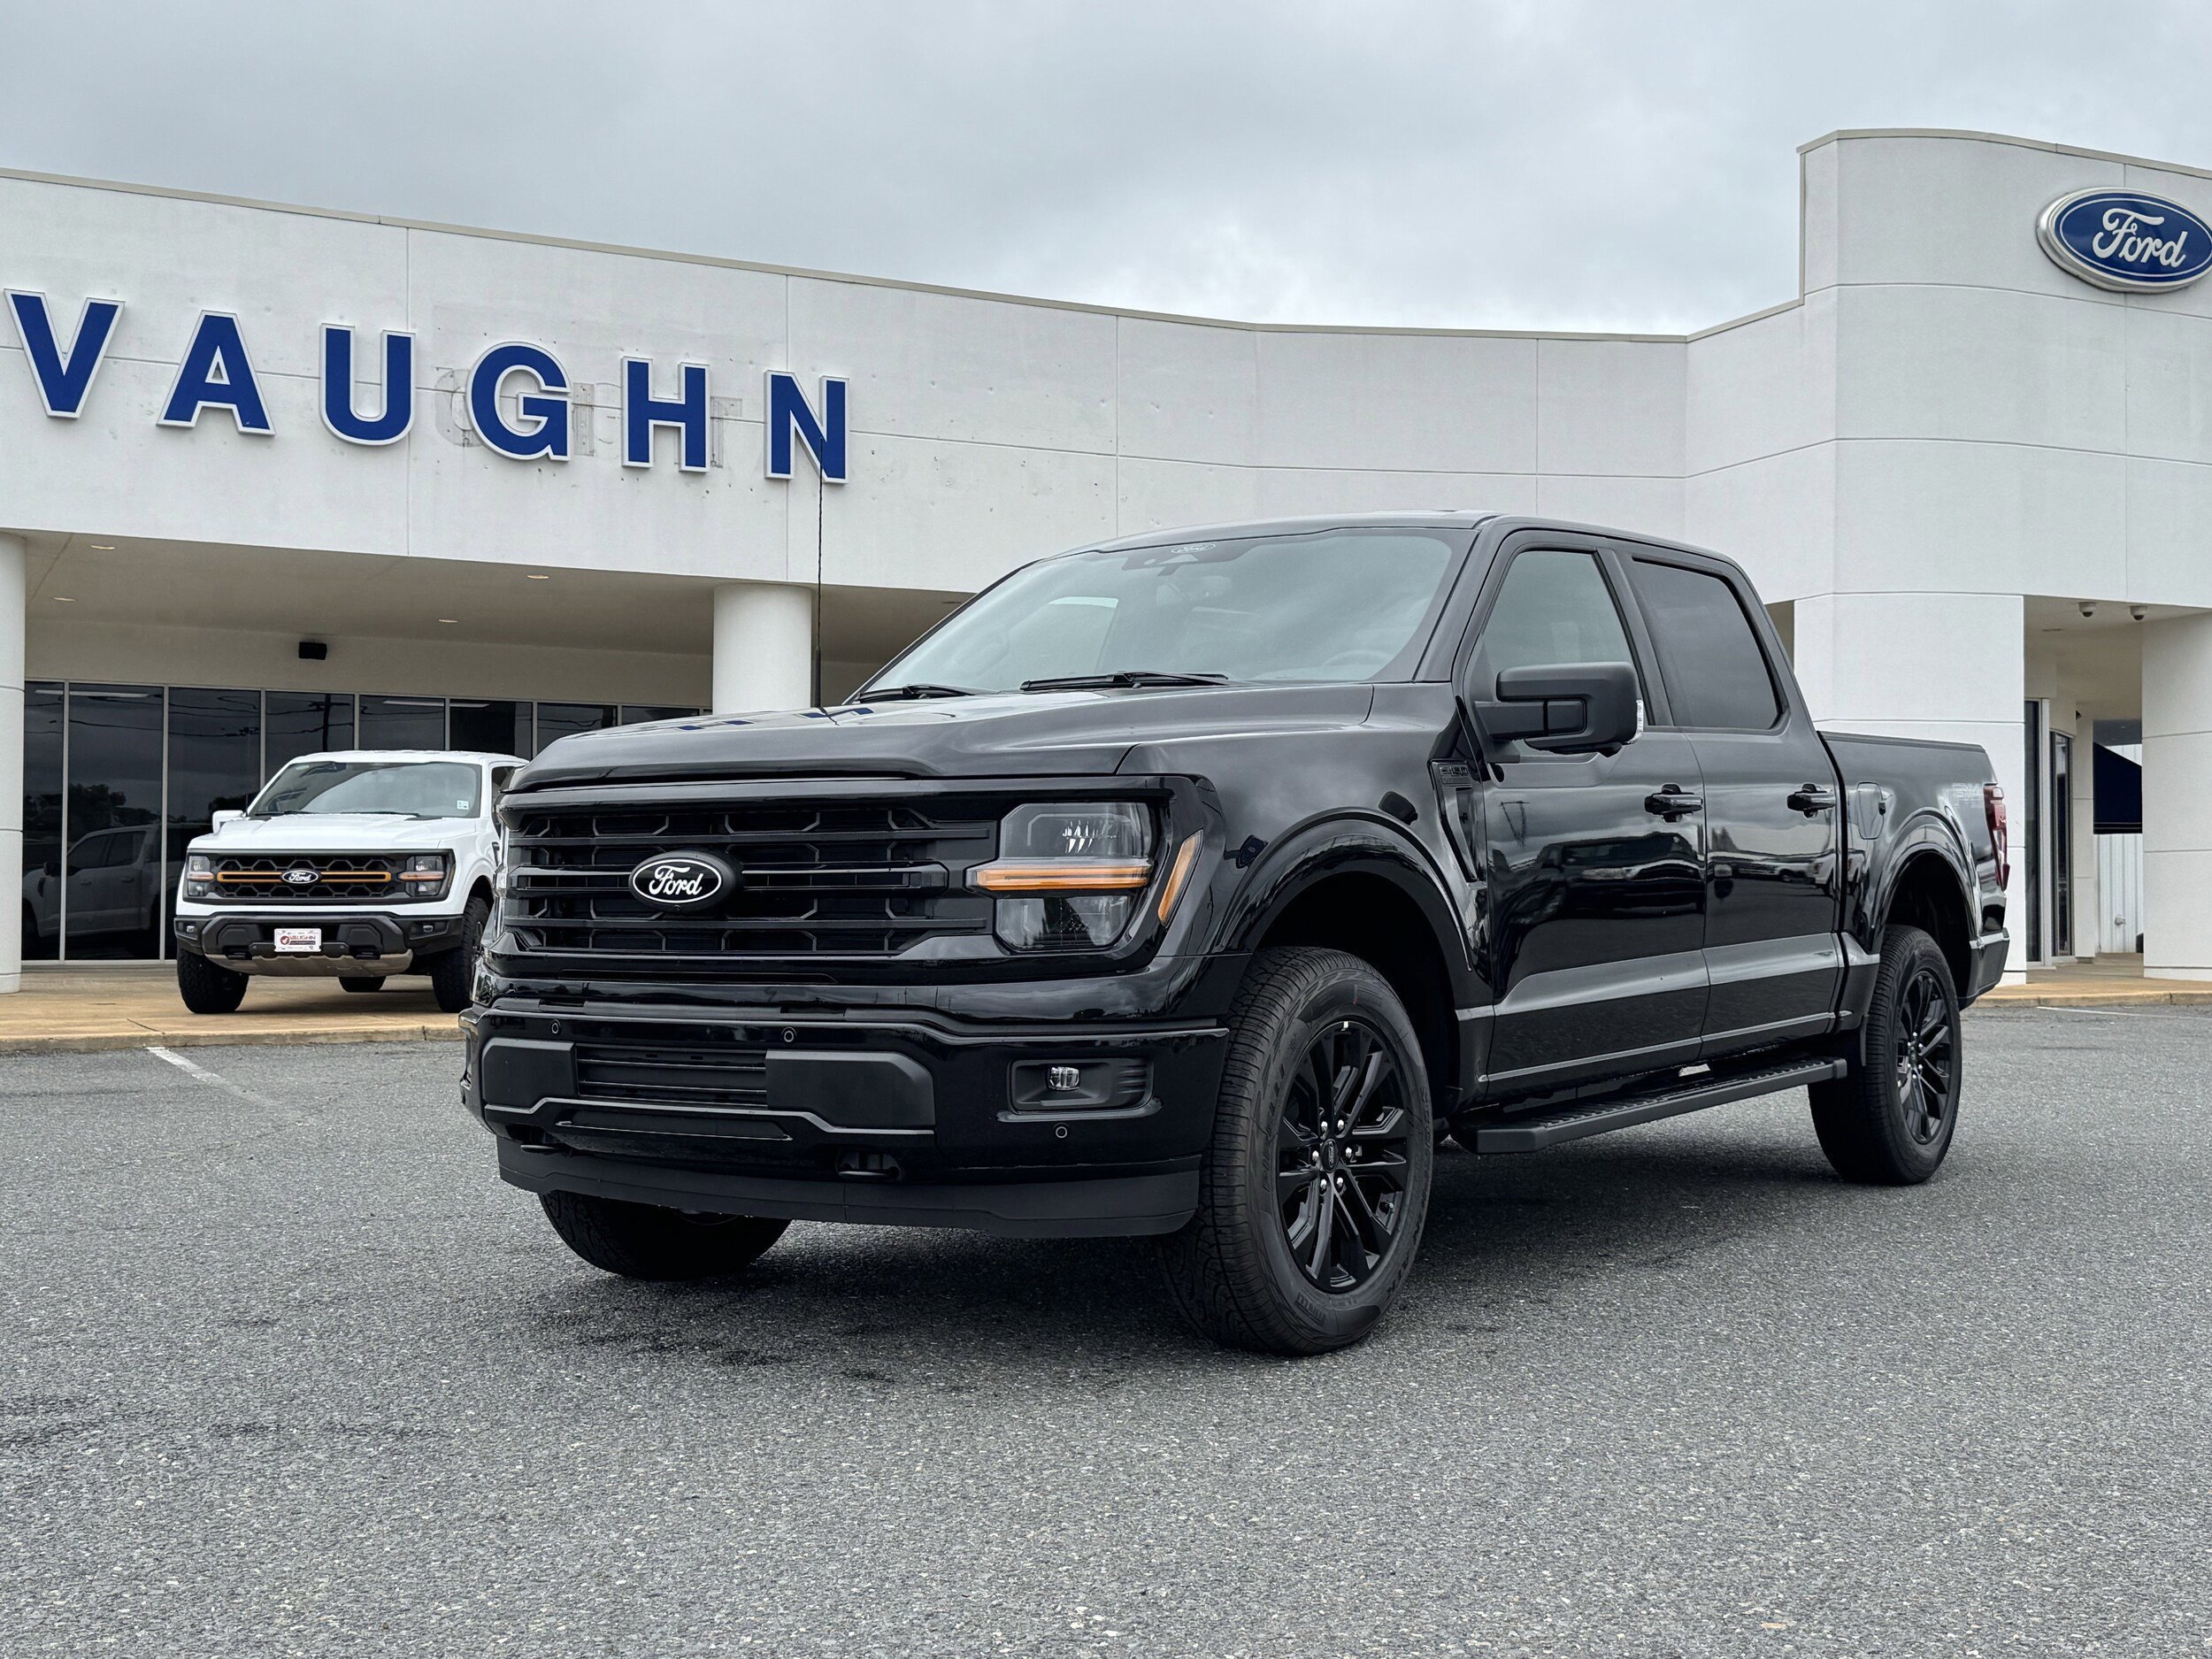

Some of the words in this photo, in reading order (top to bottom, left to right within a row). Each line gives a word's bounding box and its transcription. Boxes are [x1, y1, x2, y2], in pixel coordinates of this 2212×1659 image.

[2092, 208, 2188, 268] Ford
[4, 288, 850, 485] VAUGHN
[288, 872, 311, 881] Ford
[649, 864, 704, 895] Ford
